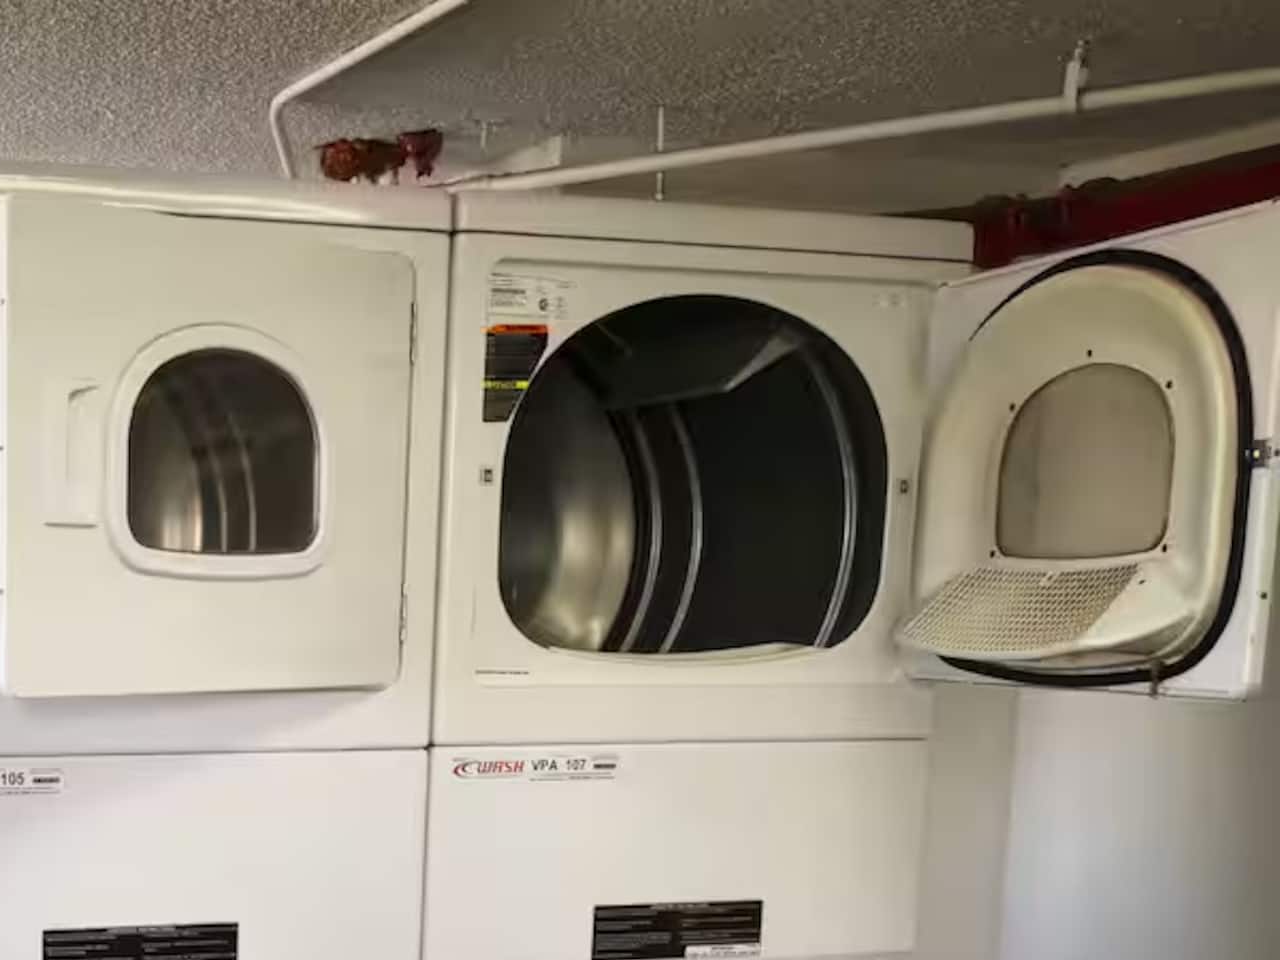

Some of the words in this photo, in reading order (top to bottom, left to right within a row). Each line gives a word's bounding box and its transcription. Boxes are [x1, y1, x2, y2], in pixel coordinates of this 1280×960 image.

[477, 760, 525, 774] WASH
[531, 760, 558, 771] VPA
[566, 759, 587, 771] 107
[1, 772, 25, 786] 105
